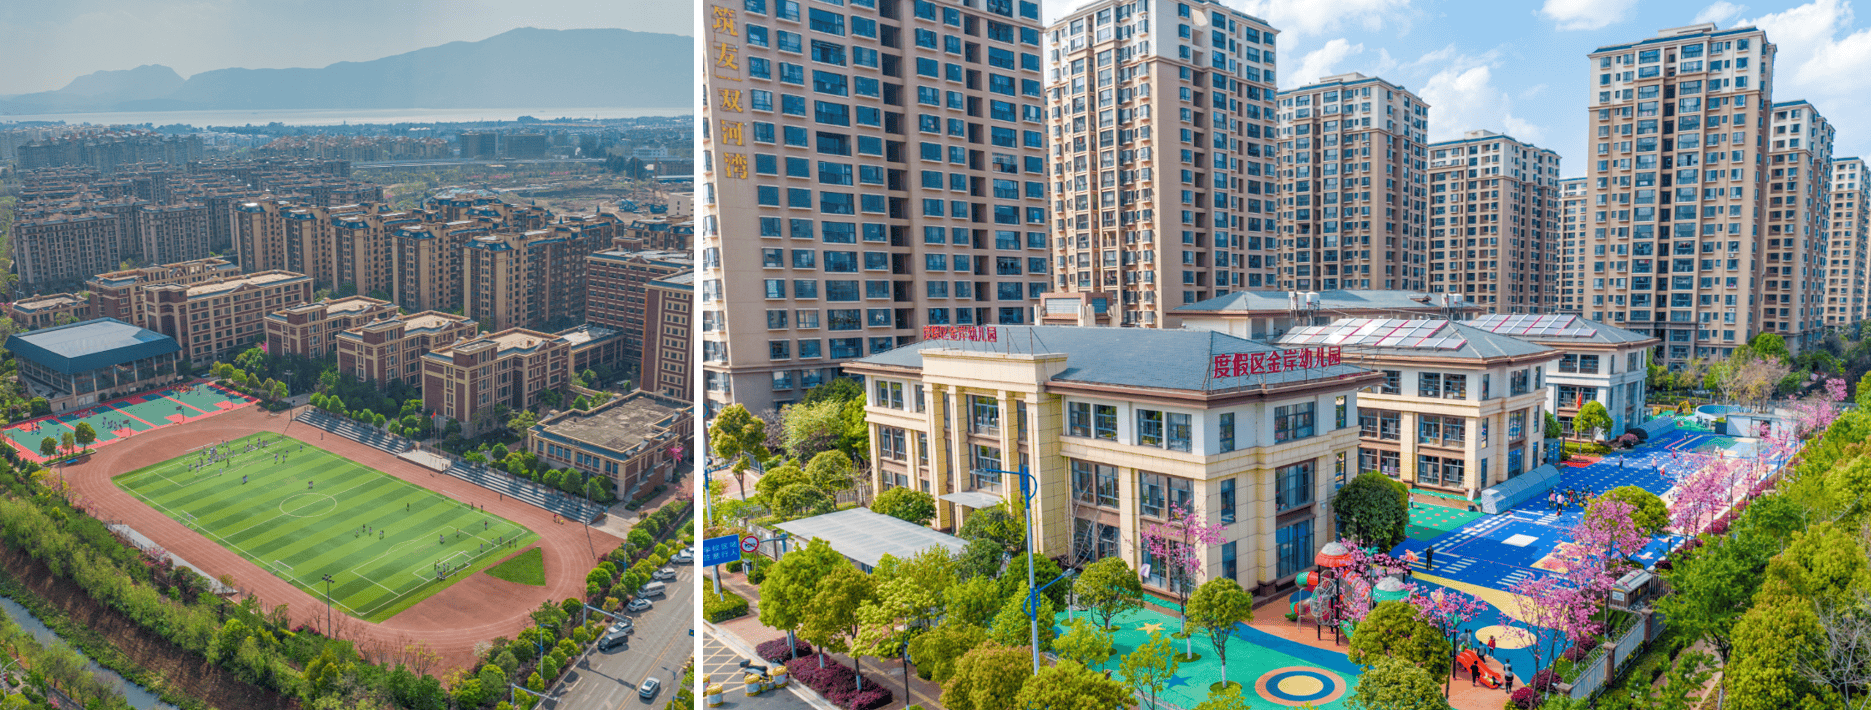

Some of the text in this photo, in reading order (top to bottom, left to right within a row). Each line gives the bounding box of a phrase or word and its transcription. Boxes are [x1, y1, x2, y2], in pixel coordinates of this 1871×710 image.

[712, 6, 748, 180] 筑友双河湾
[923, 325, 997, 342] 度假区金岸幼儿园
[1214, 346, 1341, 378] 度假区金岸幼儿园
